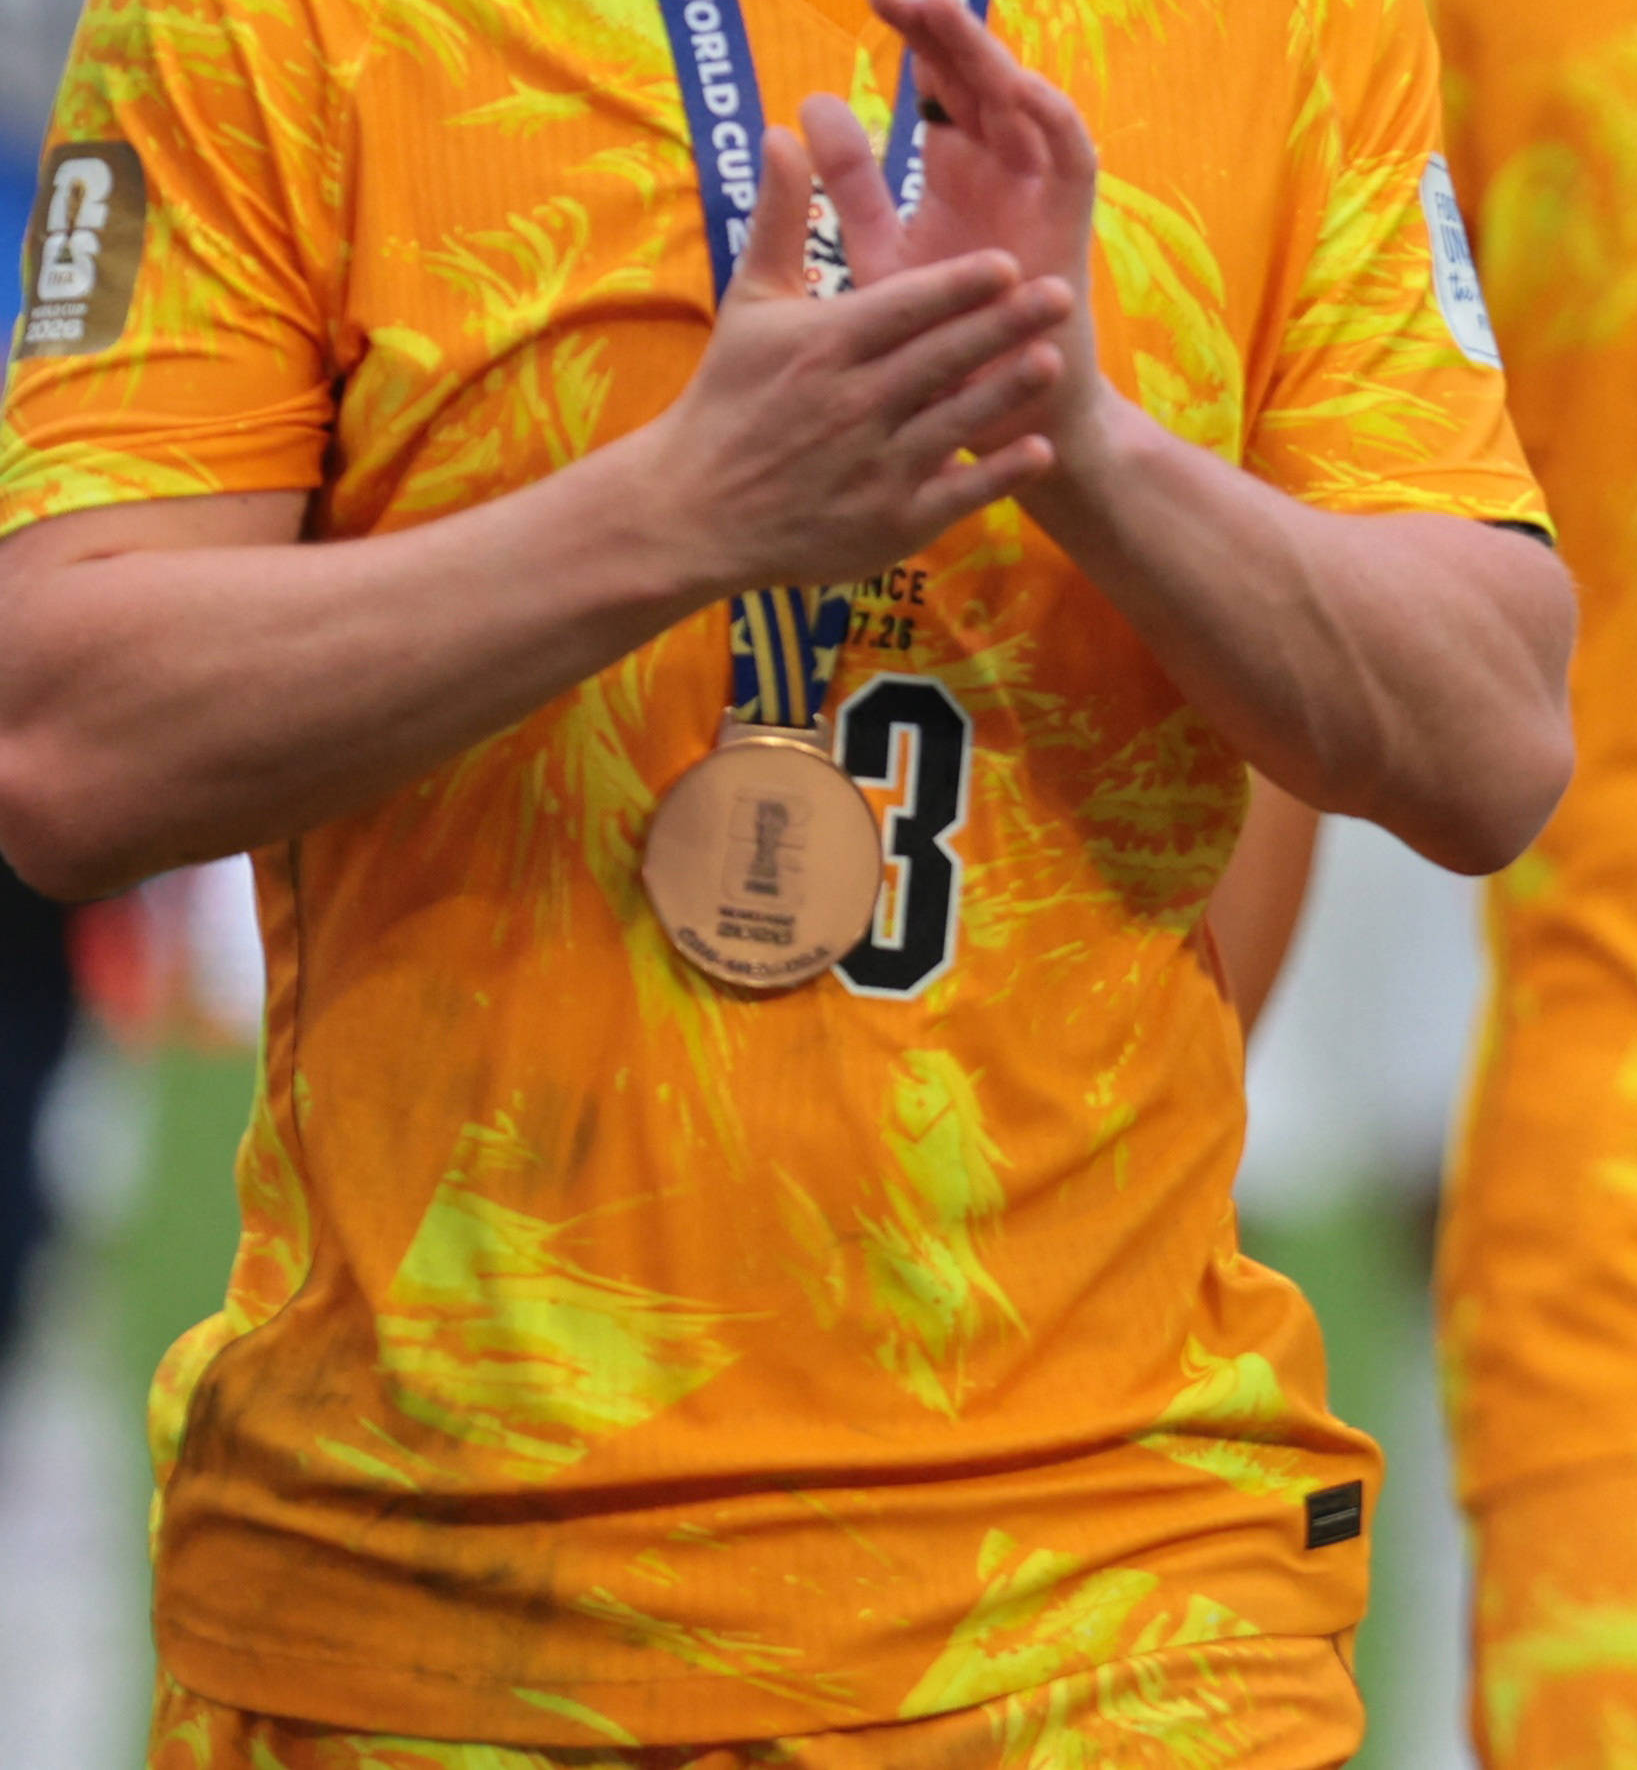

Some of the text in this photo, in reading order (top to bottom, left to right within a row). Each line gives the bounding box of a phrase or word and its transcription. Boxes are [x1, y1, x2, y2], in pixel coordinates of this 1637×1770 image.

[711, 120, 758, 211] CUP
[851, 567, 928, 606] NCE
[849, 611, 916, 652] 7.26
